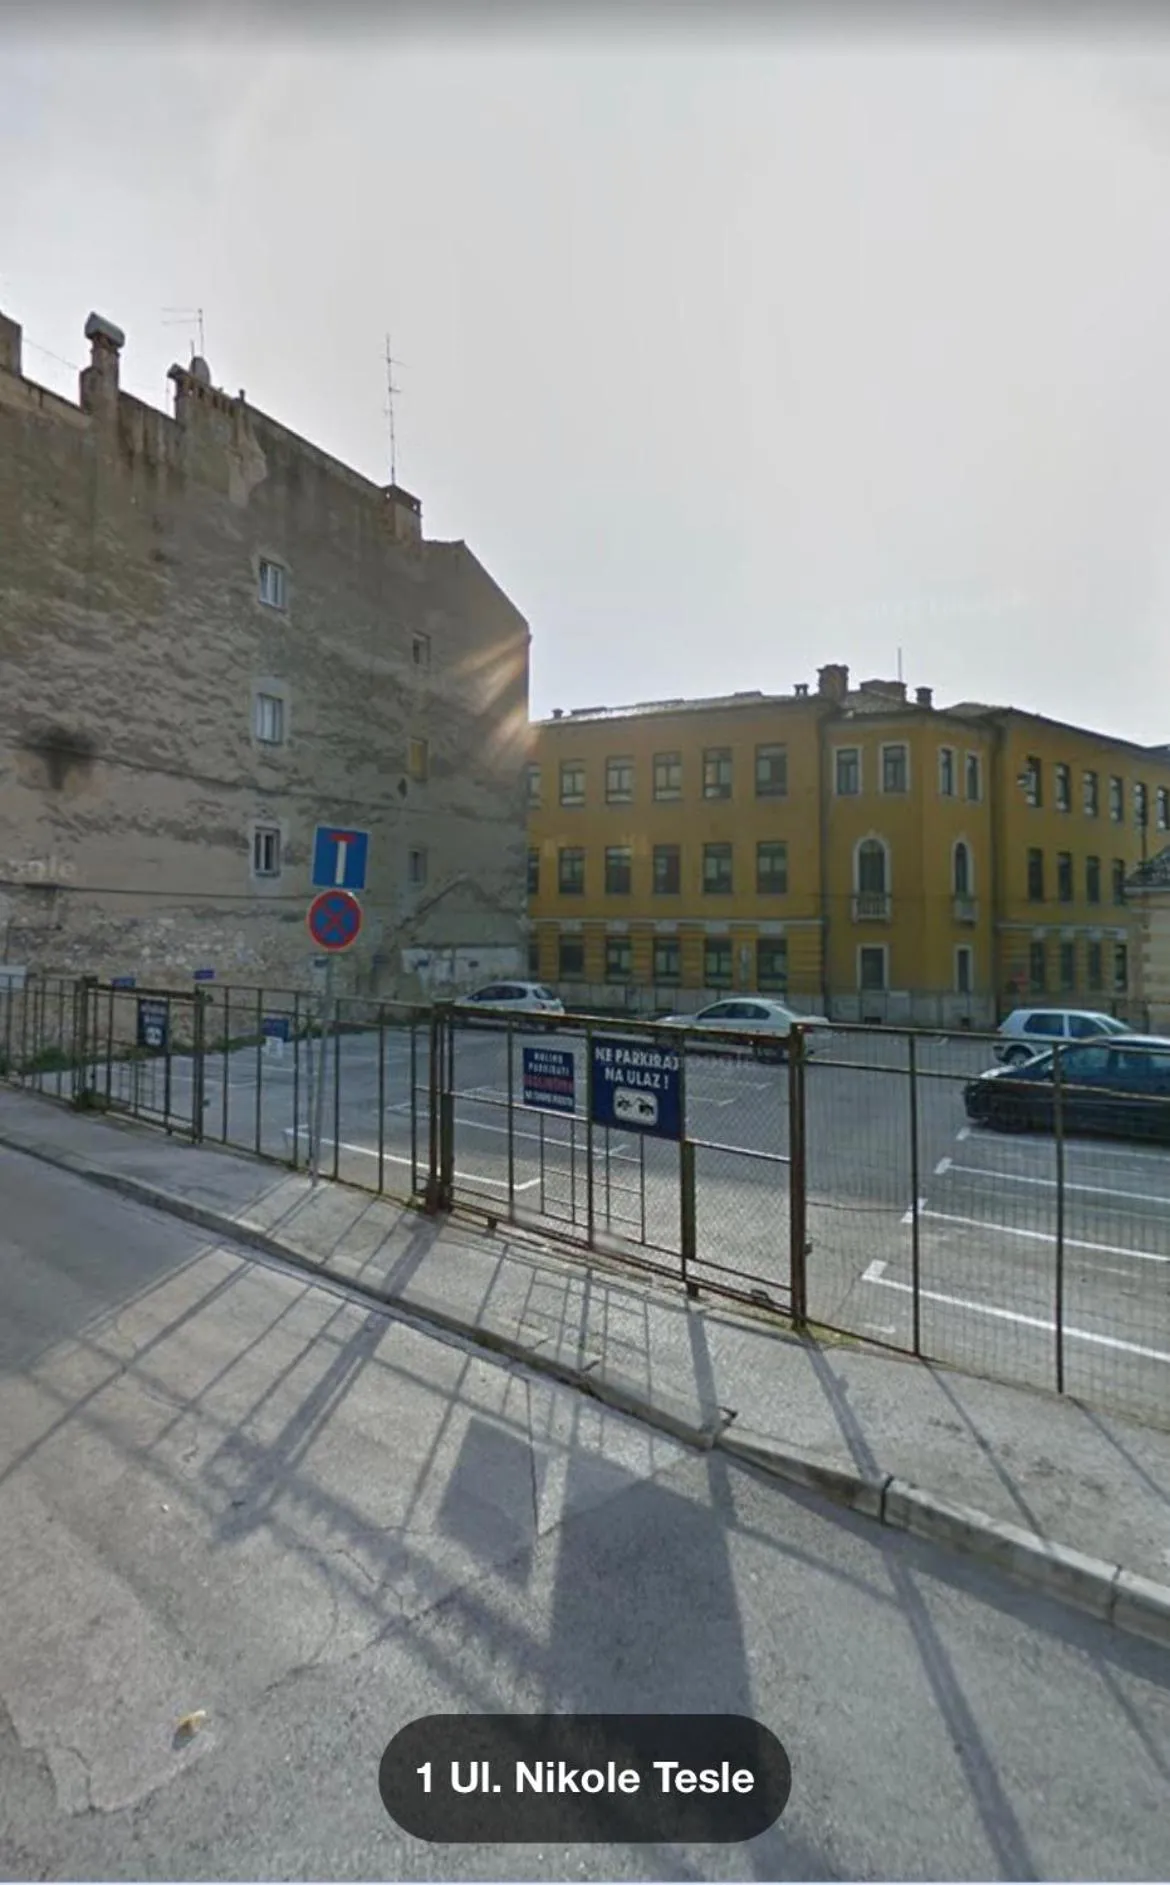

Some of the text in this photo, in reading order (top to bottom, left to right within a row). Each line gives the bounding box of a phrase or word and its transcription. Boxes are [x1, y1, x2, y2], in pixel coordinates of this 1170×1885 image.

[594, 1046, 612, 1062] NE
[615, 1048, 679, 1071] PARKIRAJ
[605, 1067, 624, 1082] NA
[627, 1069, 660, 1088] ULAZ
